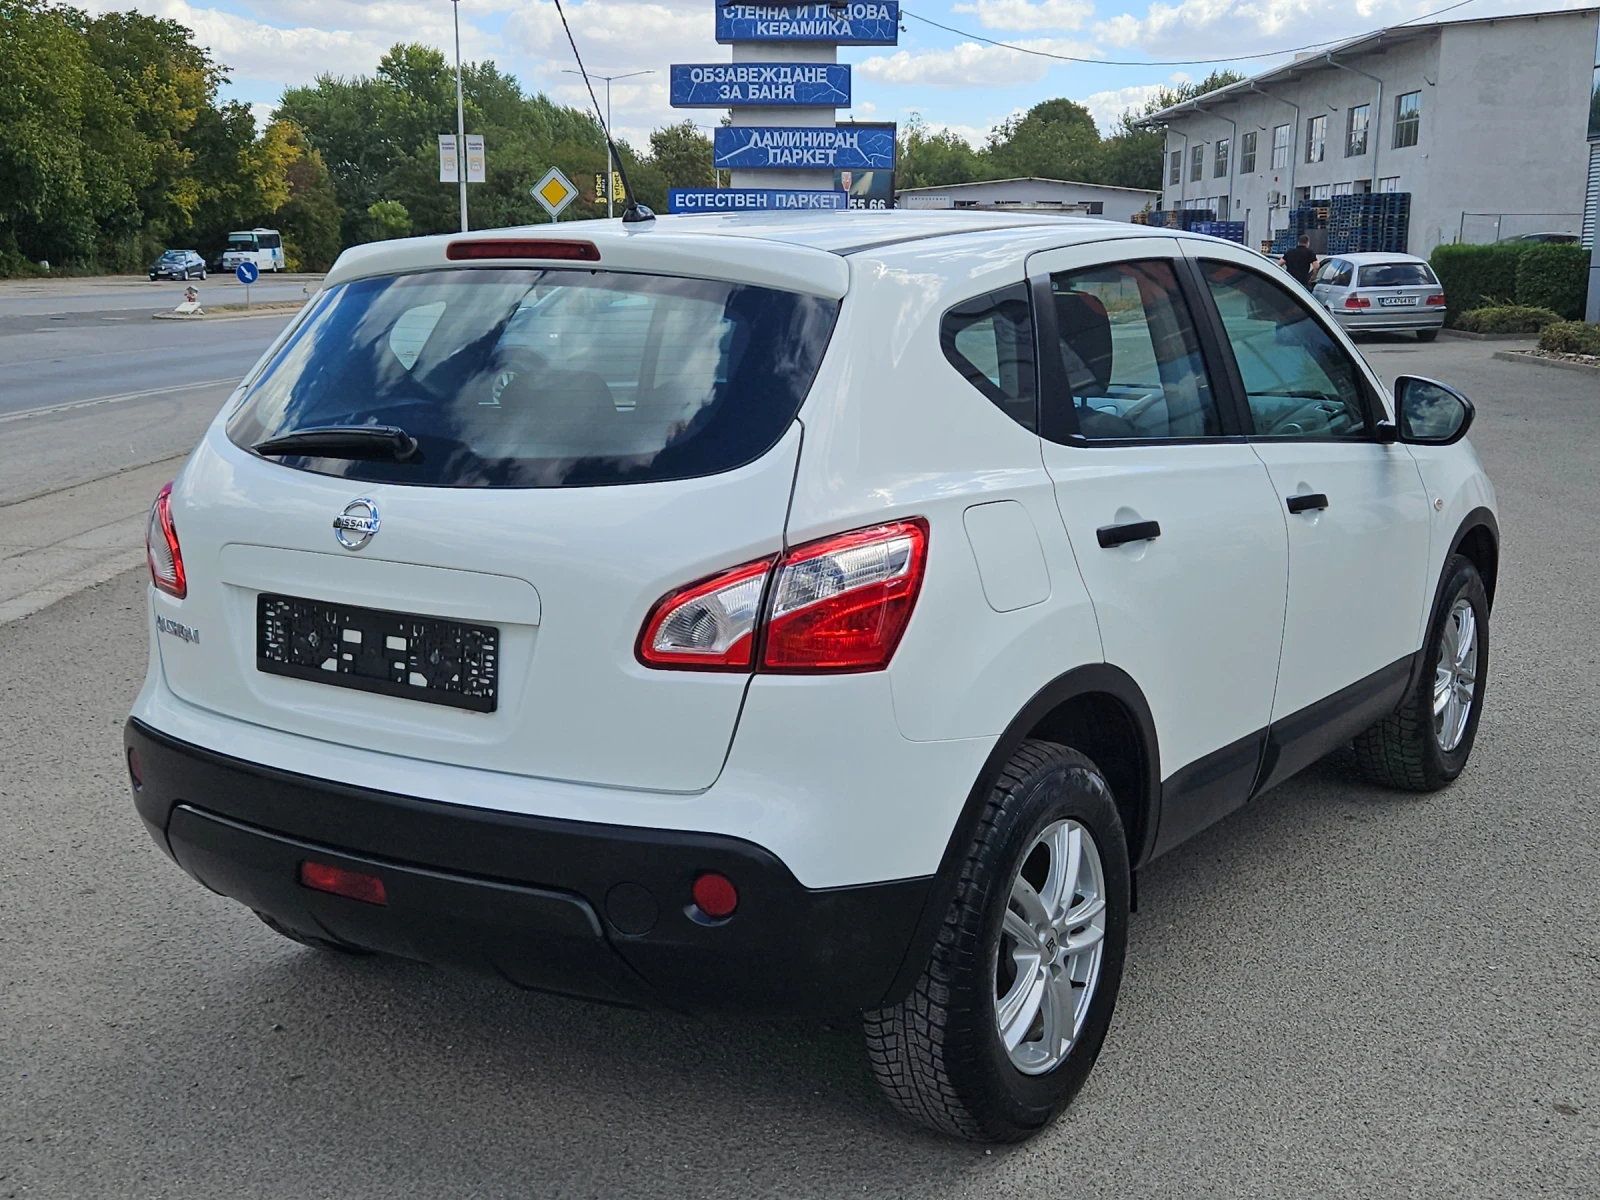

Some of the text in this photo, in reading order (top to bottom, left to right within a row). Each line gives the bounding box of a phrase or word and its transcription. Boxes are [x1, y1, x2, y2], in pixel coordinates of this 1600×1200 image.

[723, 5, 790, 20] СТЕННА
[796, 5, 809, 19] И
[756, 21, 852, 36] КЕРАМИКА
[690, 67, 827, 83] ОБЗАВЕЖДАНЕ
[719, 84, 795, 99] ЗА БАНЯ
[750, 132, 858, 148] ЛАМИНИРАН
[767, 149, 837, 165] ПАРКЕТ
[675, 193, 840, 209] ЕСТЕСТВЕН ПАРКЕТ
[333, 517, 374, 529] NISSAN
